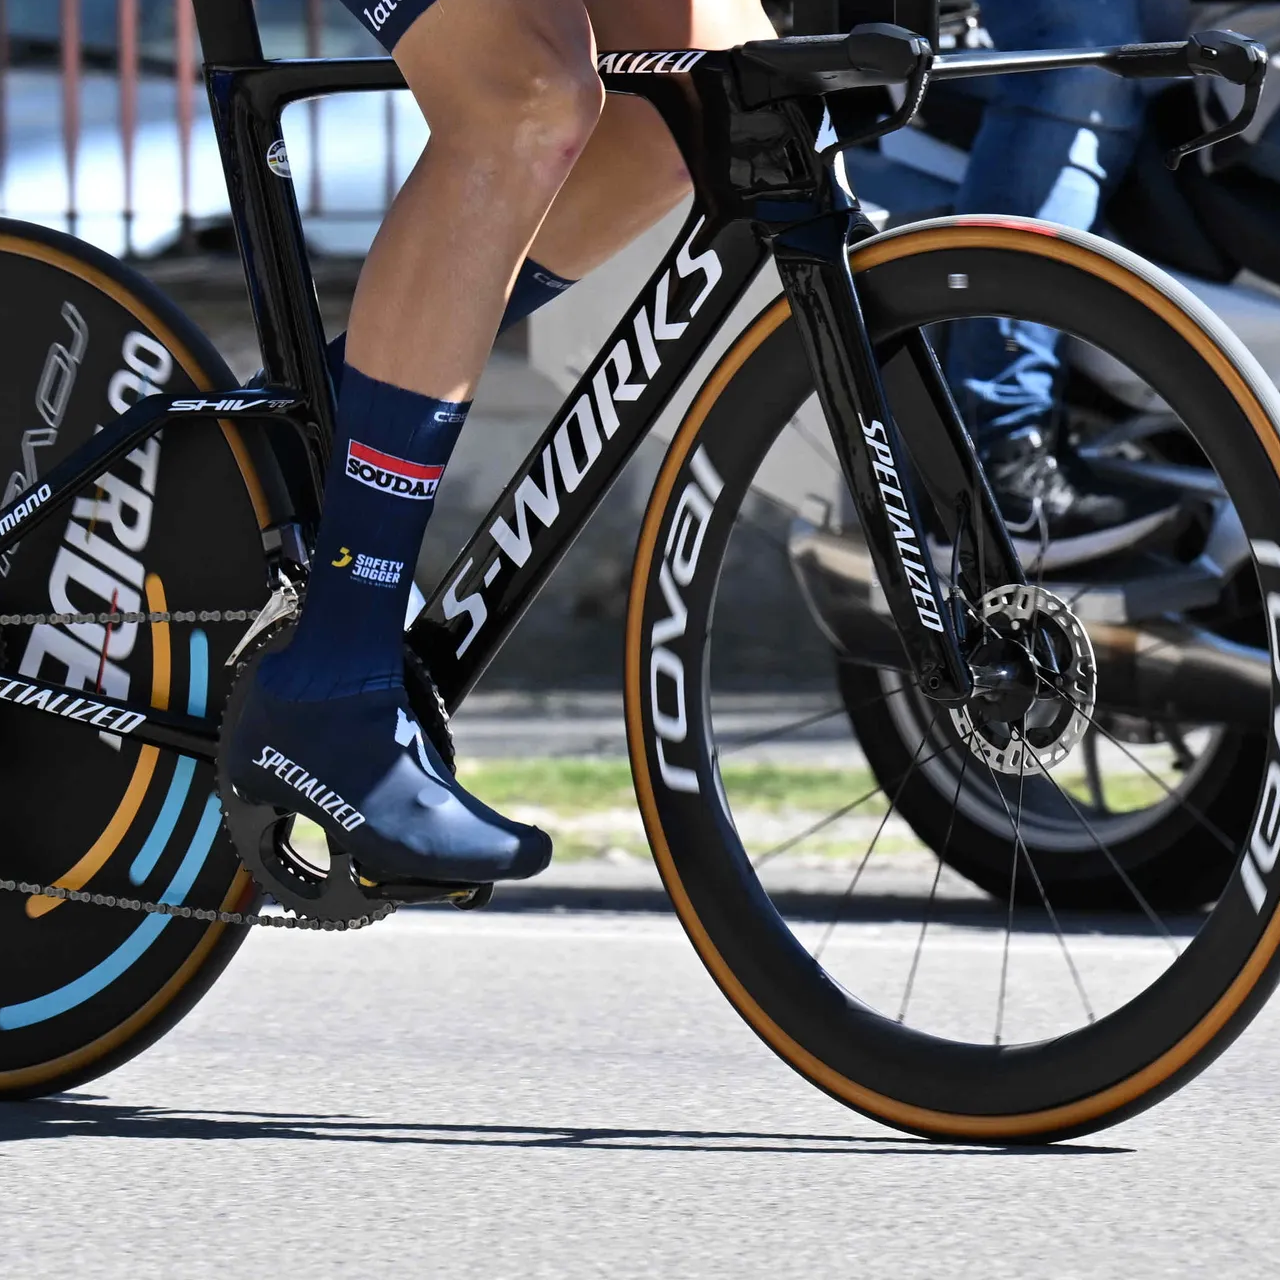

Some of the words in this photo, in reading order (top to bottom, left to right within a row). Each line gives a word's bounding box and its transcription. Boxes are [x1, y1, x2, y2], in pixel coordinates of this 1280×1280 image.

[597, 50, 708, 74] ALIZED
[166, 399, 269, 412] SHIV
[441, 213, 723, 661] S-WORKS
[347, 457, 435, 497] SOUDAL
[857, 412, 945, 633] SPECIALIZED
[351, 563, 401, 584] JOGGER
[355, 553, 404, 573] SAFETY
[251, 745, 366, 832] SPECIALIZED
